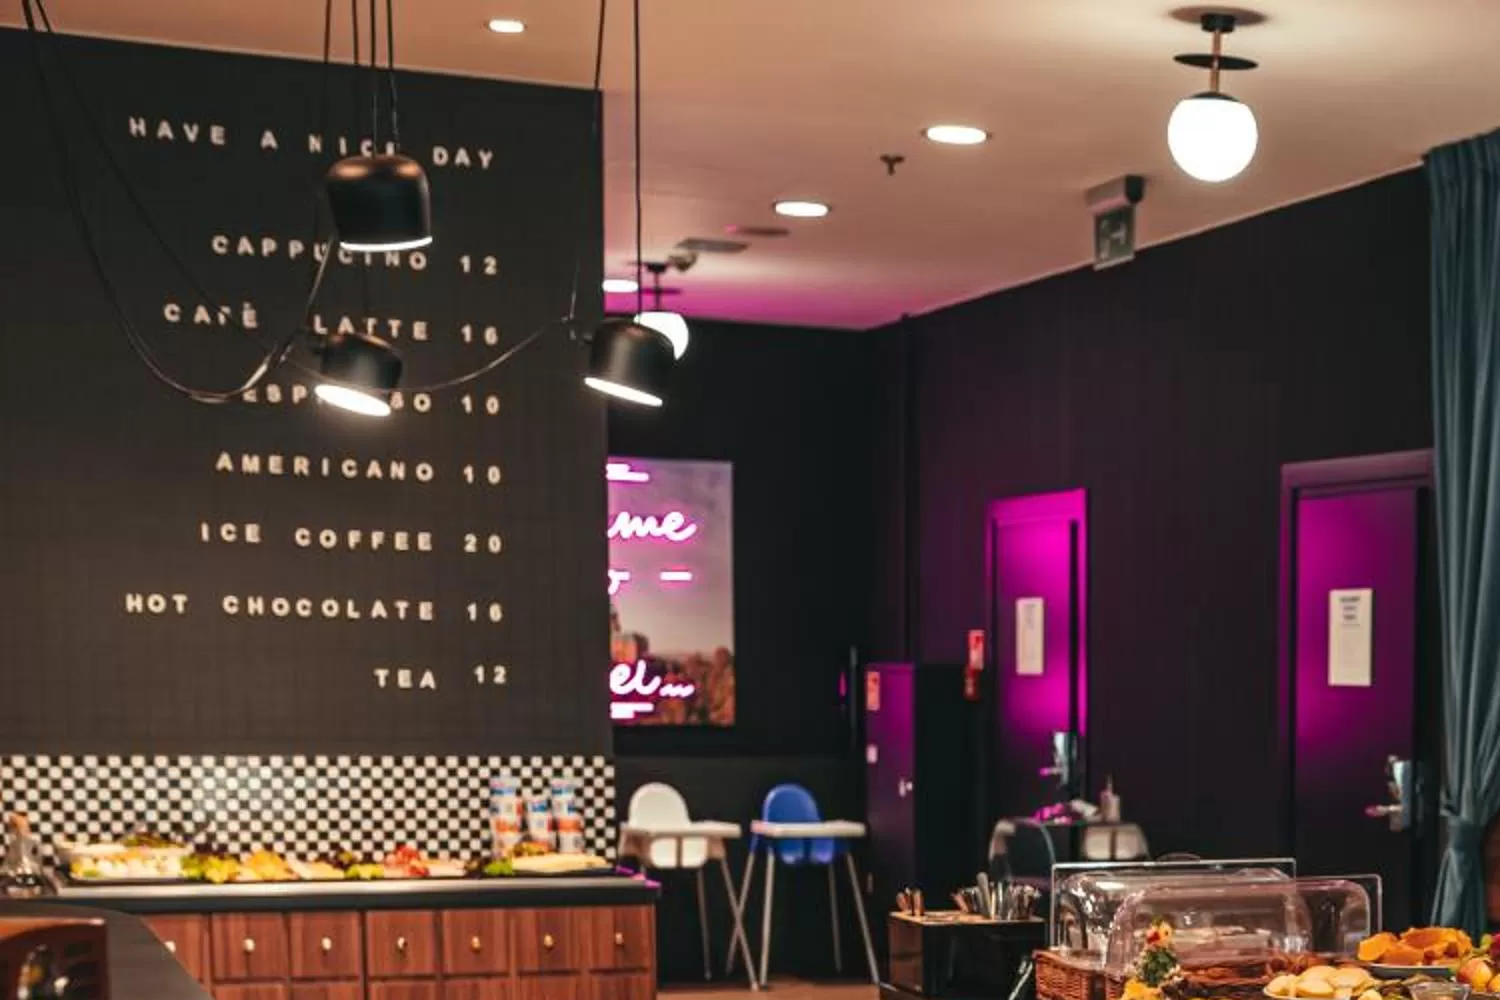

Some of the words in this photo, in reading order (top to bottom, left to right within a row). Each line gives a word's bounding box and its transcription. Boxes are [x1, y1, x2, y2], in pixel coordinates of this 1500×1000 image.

[129, 117, 225, 145] HAVE
[261, 131, 277, 148] A
[433, 146, 493, 169] DAY
[460, 255, 497, 275] 12
[313, 315, 430, 342] LATTE
[243, 383, 433, 414] ESPSO
[461, 394, 500, 415] 10
[215, 452, 434, 482] AMERICANO
[463, 465, 501, 485] 10
[200, 522, 261, 544] ICE
[294, 527, 433, 552] COFFEE
[463, 533, 502, 554] 20
[125, 593, 189, 615] HOT
[221, 594, 433, 621] CHOCOLATE
[373, 668, 437, 690] TEA
[474, 665, 507, 685] 12
